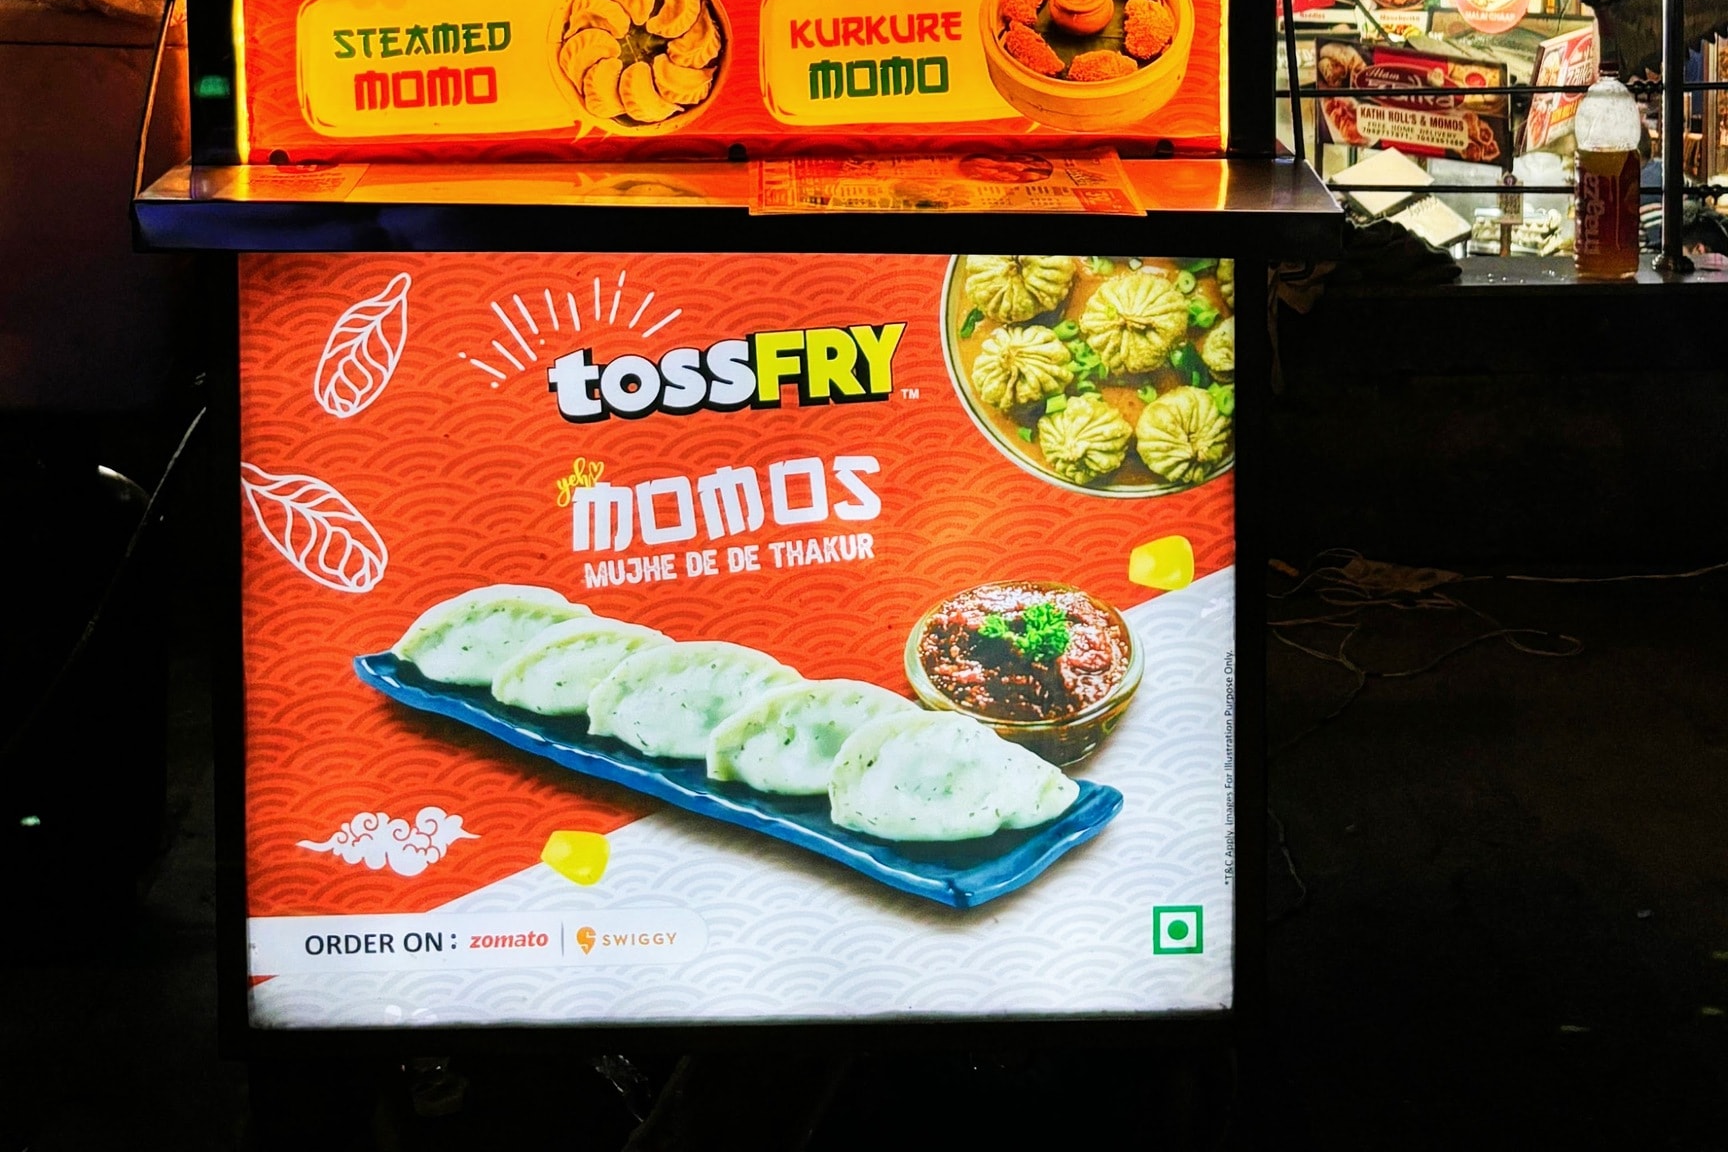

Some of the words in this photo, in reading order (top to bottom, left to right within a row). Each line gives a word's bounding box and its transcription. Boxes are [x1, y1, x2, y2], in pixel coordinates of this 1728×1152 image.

[333, 21, 512, 59] STEAMED
[790, 11, 962, 49] KURKURE
[354, 65, 498, 112] MOMO
[808, 55, 950, 100] MOMO
[1360, 106, 1386, 121] KATHI
[1419, 114, 1427, 127] &
[1429, 116, 1465, 132] MOMOS
[547, 323, 909, 424] tossFRY
[572, 454, 882, 554] MOMOS
[584, 553, 678, 590] MUJHE
[685, 549, 718, 580] DE
[727, 545, 760, 575] DE
[768, 532, 876, 568] THAKUR
[1224, 679, 1235, 717] Purpose
[1224, 719, 1234, 771] Illustration
[1224, 773, 1234, 789] For
[1224, 791, 1235, 826] Images
[305, 932, 396, 956] ORDER
[470, 929, 549, 950] zomato
[602, 931, 677, 947] SWIGGY
